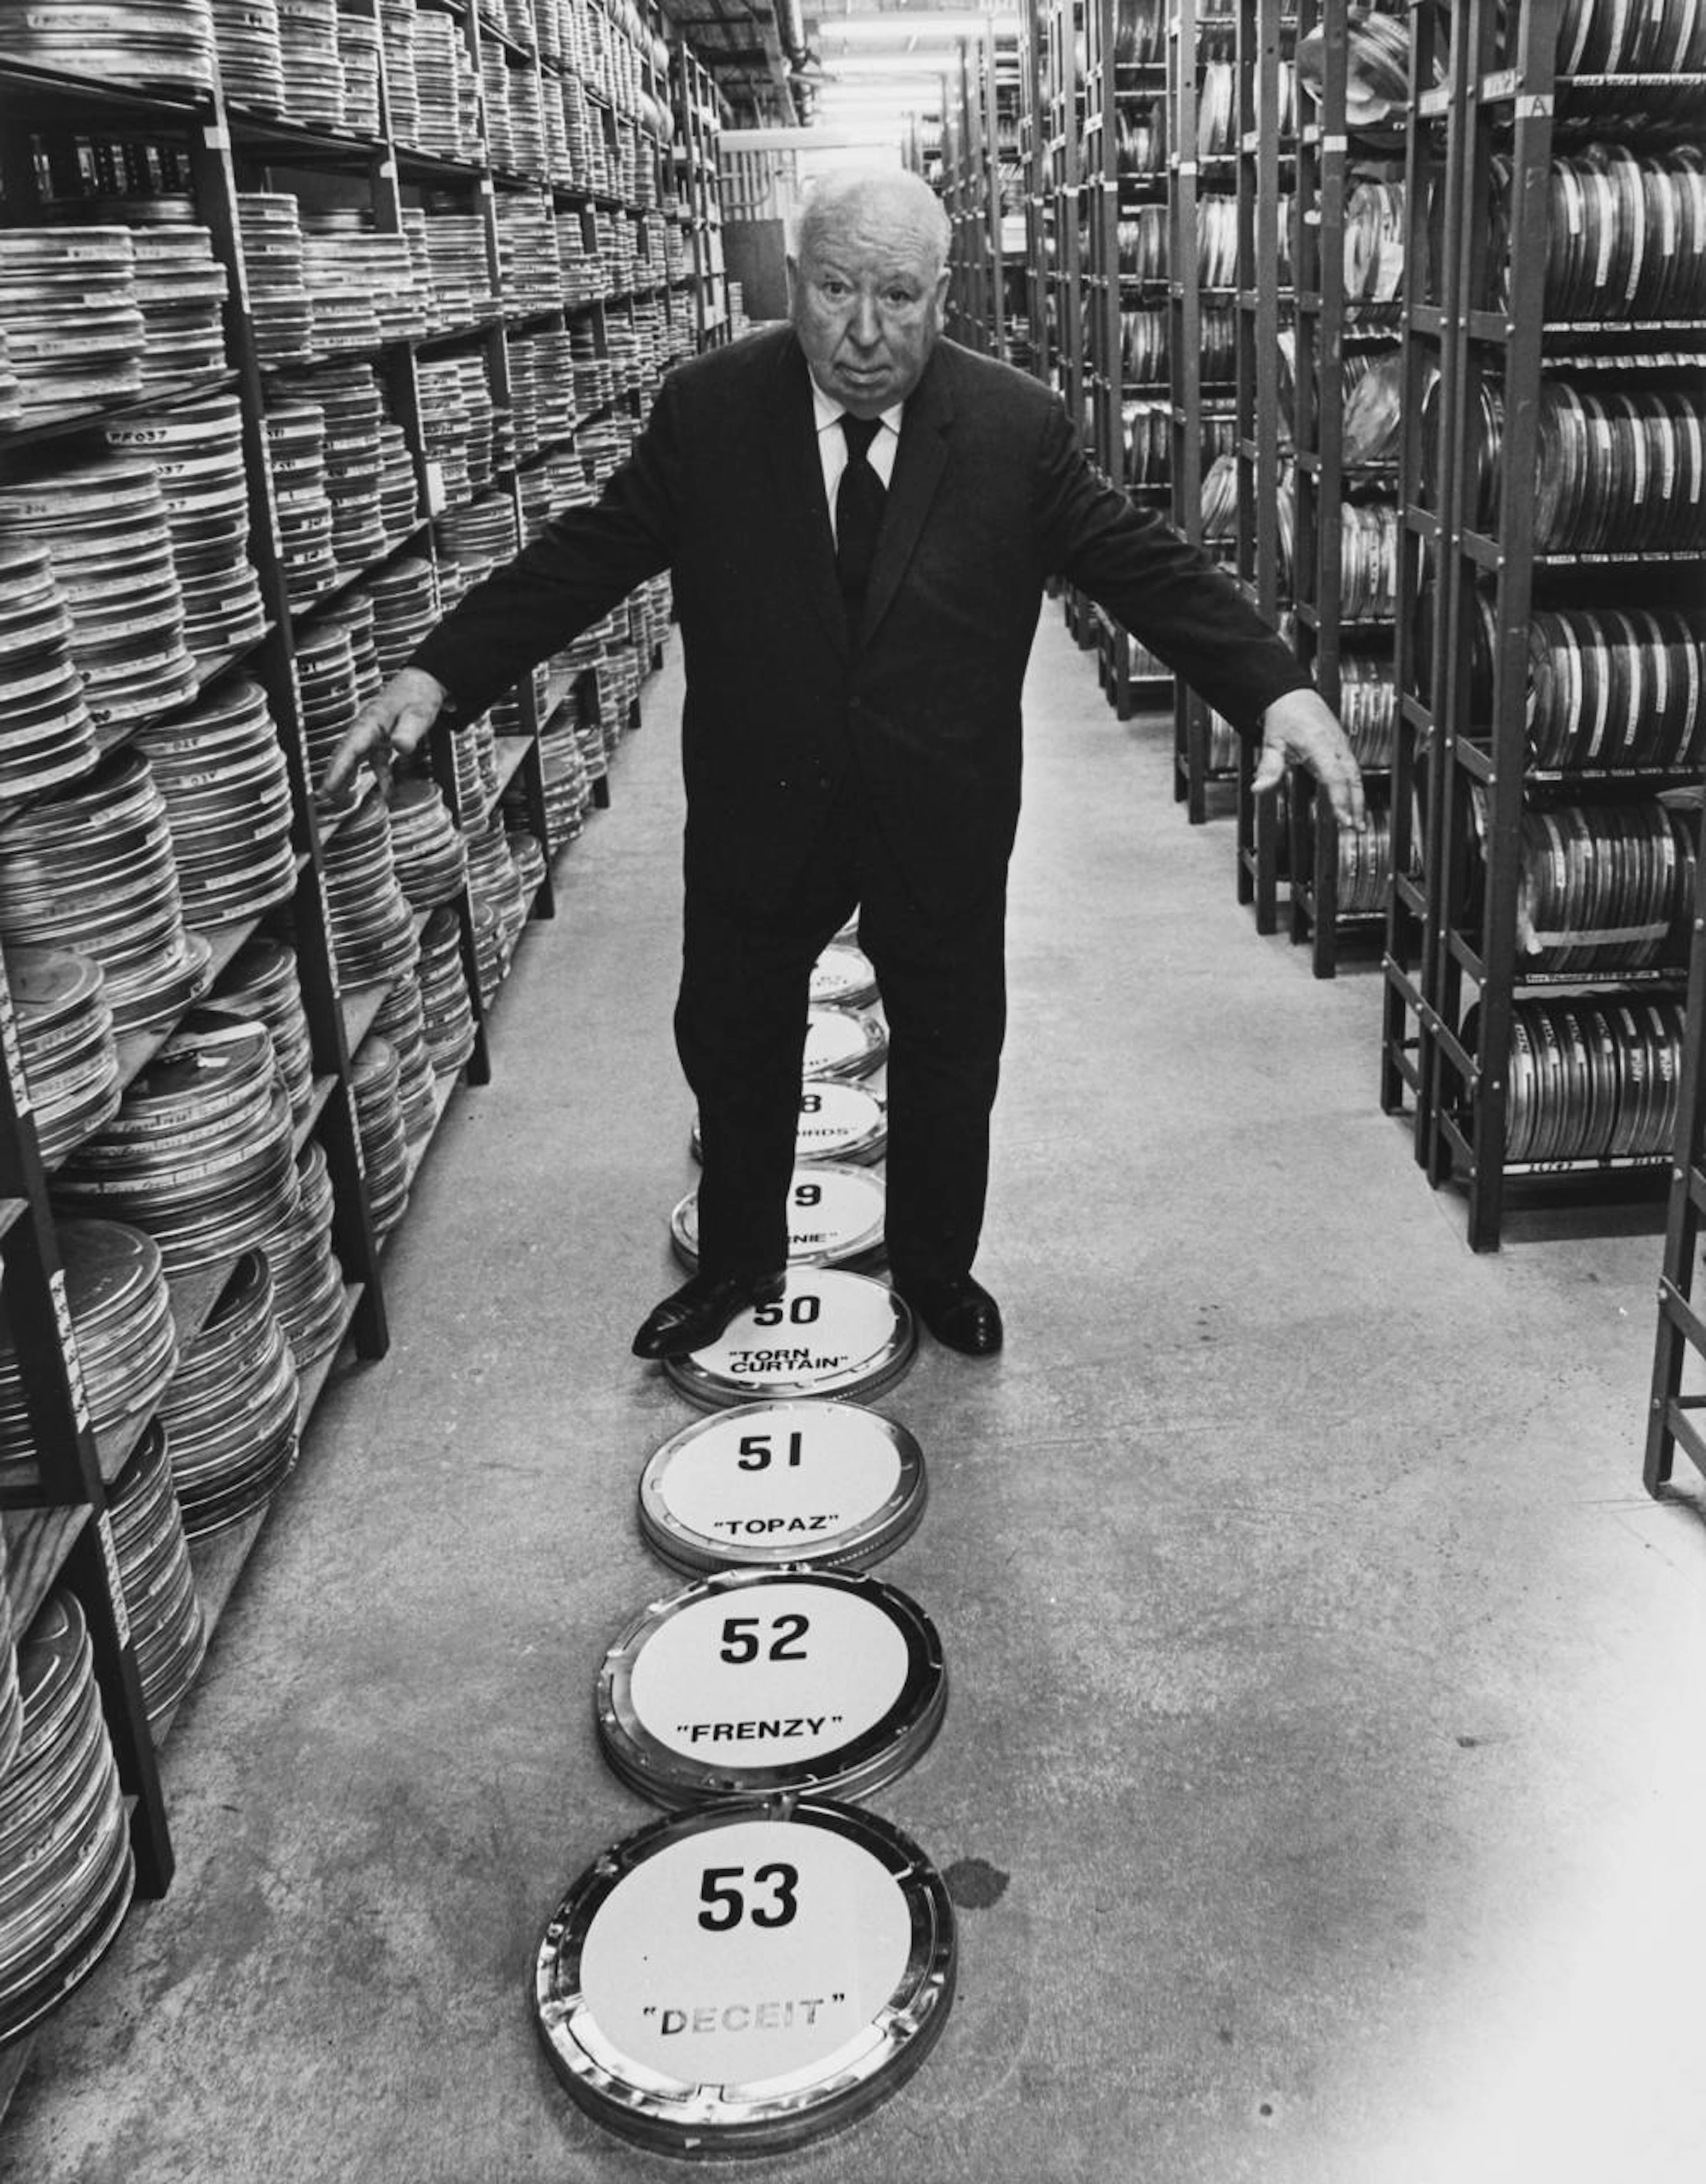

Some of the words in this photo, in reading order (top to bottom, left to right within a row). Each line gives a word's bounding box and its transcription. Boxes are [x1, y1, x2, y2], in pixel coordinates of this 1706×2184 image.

[1531, 96, 1547, 117] A
[788, 1231, 838, 1244] NIE"
[753, 1295, 821, 1326] 50
[729, 1348, 809, 1362] "TORN
[730, 1356, 849, 1373] CURTAIN"
[737, 1432, 802, 1471] 51
[714, 1514, 839, 1535] "TOPAZ"
[720, 1614, 810, 1665] 52
[677, 1715, 843, 1743] "FRENZY"
[698, 1862, 799, 1932] 53
[642, 1992, 845, 2036] "DECEIT"
